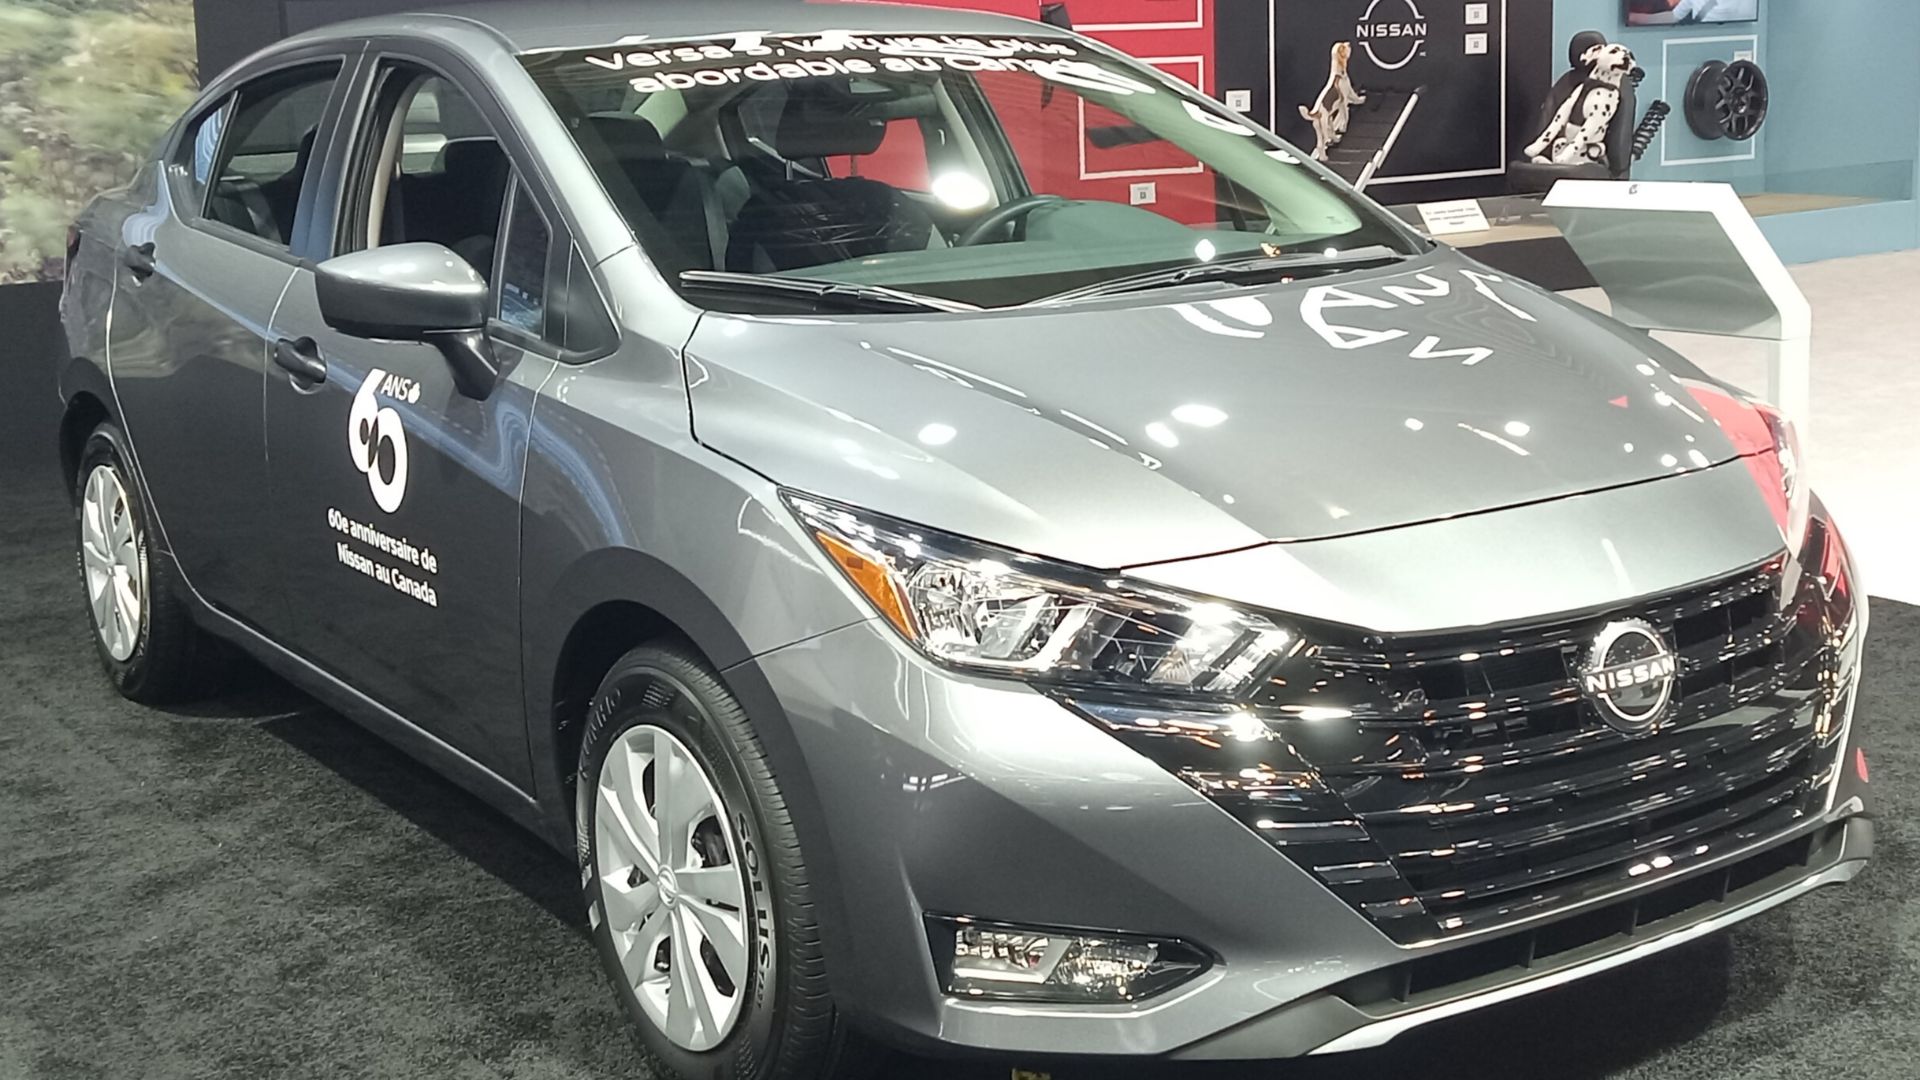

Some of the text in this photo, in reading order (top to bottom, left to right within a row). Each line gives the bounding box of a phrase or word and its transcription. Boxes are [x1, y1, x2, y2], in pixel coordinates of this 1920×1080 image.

[585, 45, 734, 71] Versa
[783, 36, 937, 52] viture
[1356, 23, 1427, 38] NISSAN
[629, 57, 876, 93] abordable
[880, 57, 942, 72] au
[348, 368, 412, 513] 60 ANS
[327, 508, 438, 574] 60e anniversaire de
[337, 542, 438, 607] Nissan au Canada
[1585, 655, 1676, 693] NISSAN
[736, 812, 771, 969] SOLUS
